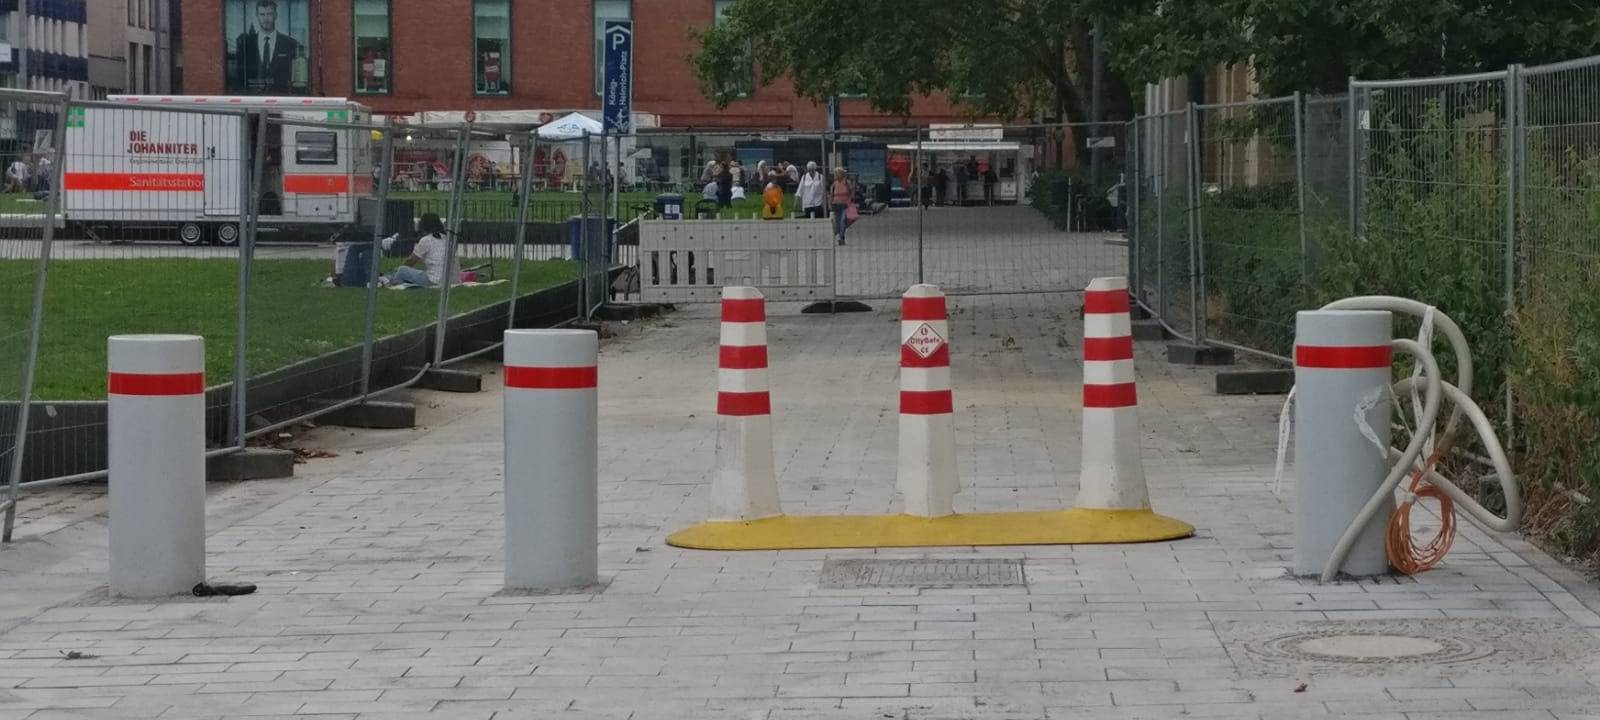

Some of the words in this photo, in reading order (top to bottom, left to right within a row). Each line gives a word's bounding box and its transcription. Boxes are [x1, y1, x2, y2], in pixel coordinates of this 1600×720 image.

[612, 33, 625, 51] P
[129, 130, 147, 142] DIE
[127, 143, 198, 154] JOHANNITER
